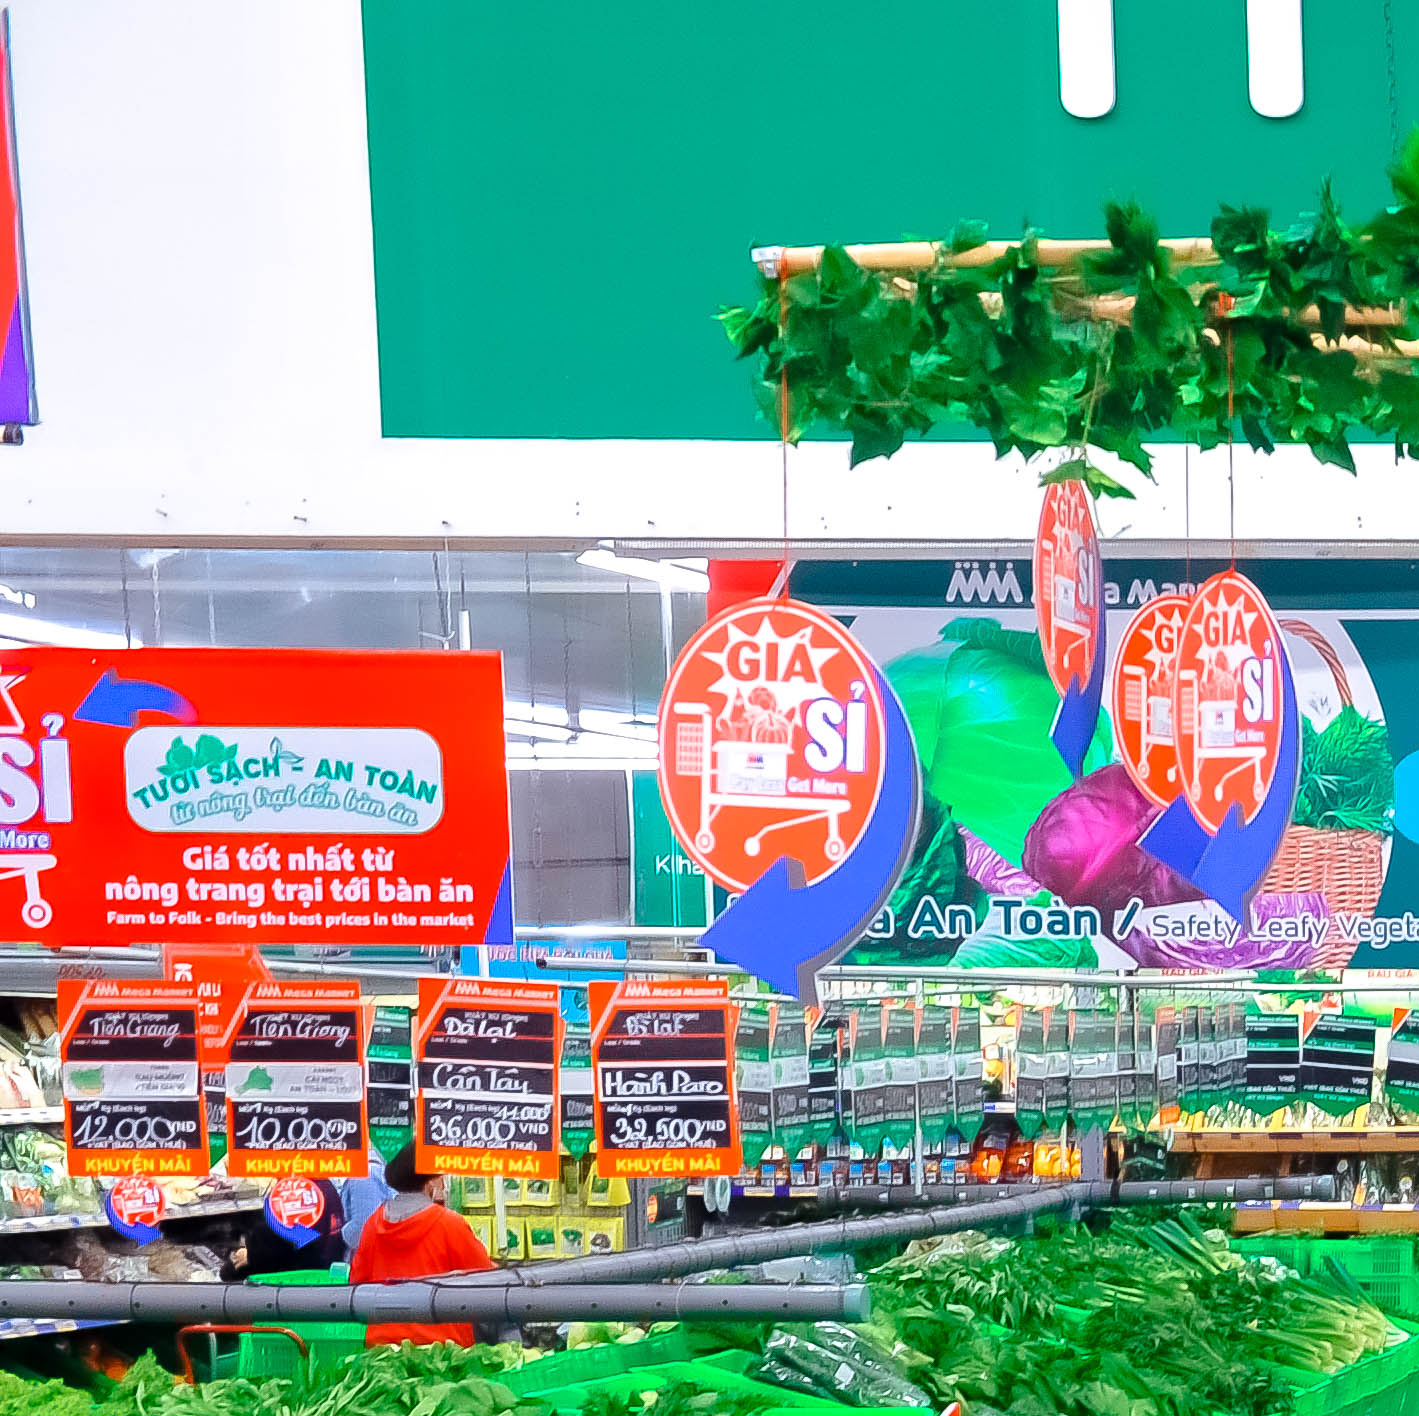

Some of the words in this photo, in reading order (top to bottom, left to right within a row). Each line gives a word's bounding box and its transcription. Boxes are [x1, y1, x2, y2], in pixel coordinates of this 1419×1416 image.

[315, 758, 353, 782] AN
[365, 764, 438, 804] TOÀN
[183, 846, 229, 871] Giá
[237, 843, 281, 871] tốt
[288, 843, 355, 871] nhất
[362, 848, 395, 871] từ
[105, 877, 179, 907] nông
[186, 880, 265, 907] trang
[272, 877, 323, 908] trại
[330, 878, 371, 902] tới
[378, 878, 431, 902] bàn
[439, 878, 474, 902] ăn
[106, 912, 145, 926] Farm
[149, 913, 165, 926] to
[216, 911, 256, 928] Bring
[259, 912, 286, 926] the
[289, 912, 322, 926] best
[325, 911, 371, 928] prices
[391, 912, 416, 926] the
[419, 911, 475, 927] market
[909, 895, 976, 939] An
[992, 894, 1099, 938] Toàn
[1151, 914, 1239, 948] Safety
[431, 1115, 515, 1142] 36.000
[520, 1123, 549, 1135] VND
